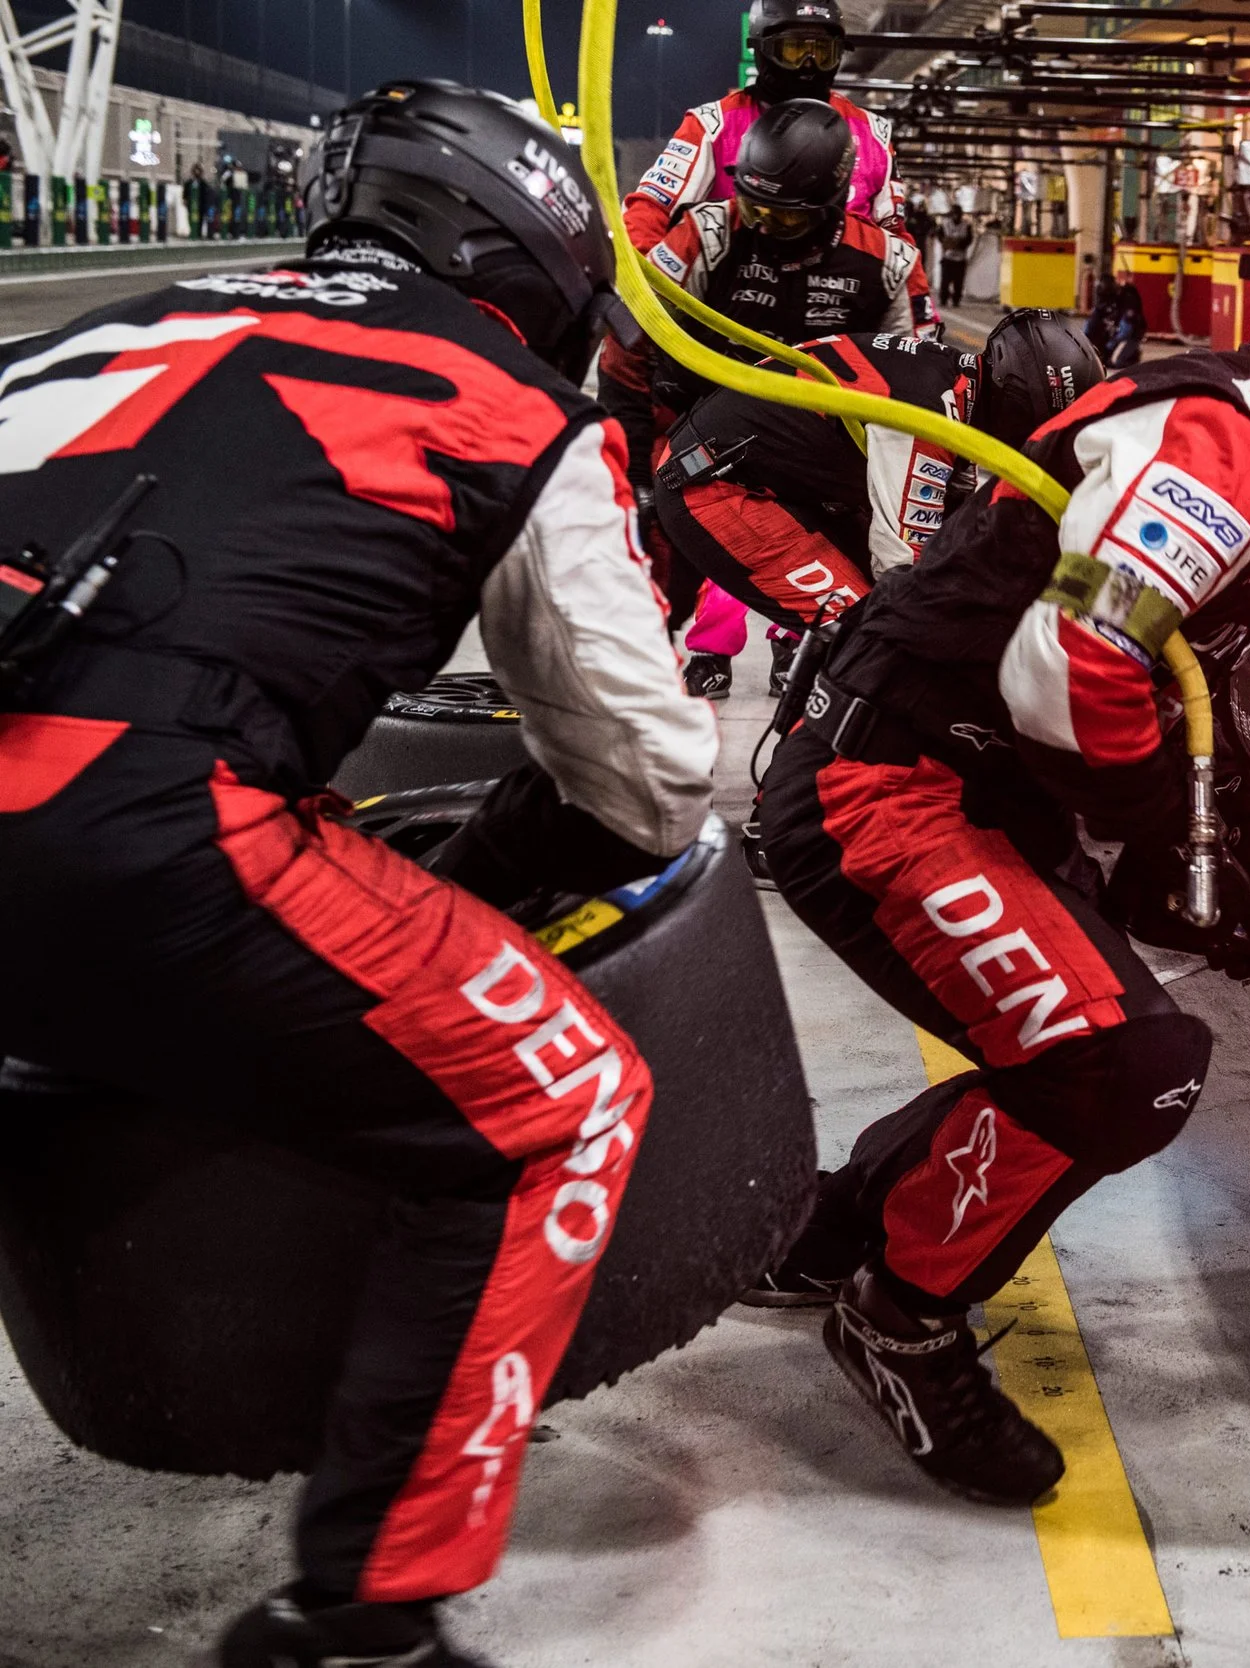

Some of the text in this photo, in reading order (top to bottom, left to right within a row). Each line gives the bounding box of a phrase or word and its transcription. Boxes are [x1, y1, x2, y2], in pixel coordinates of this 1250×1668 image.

[524, 138, 592, 224] uvex
[1152, 478, 1244, 549] RAYS
[1165, 546, 1208, 587] JFE
[458, 938, 636, 1265] DENSO
